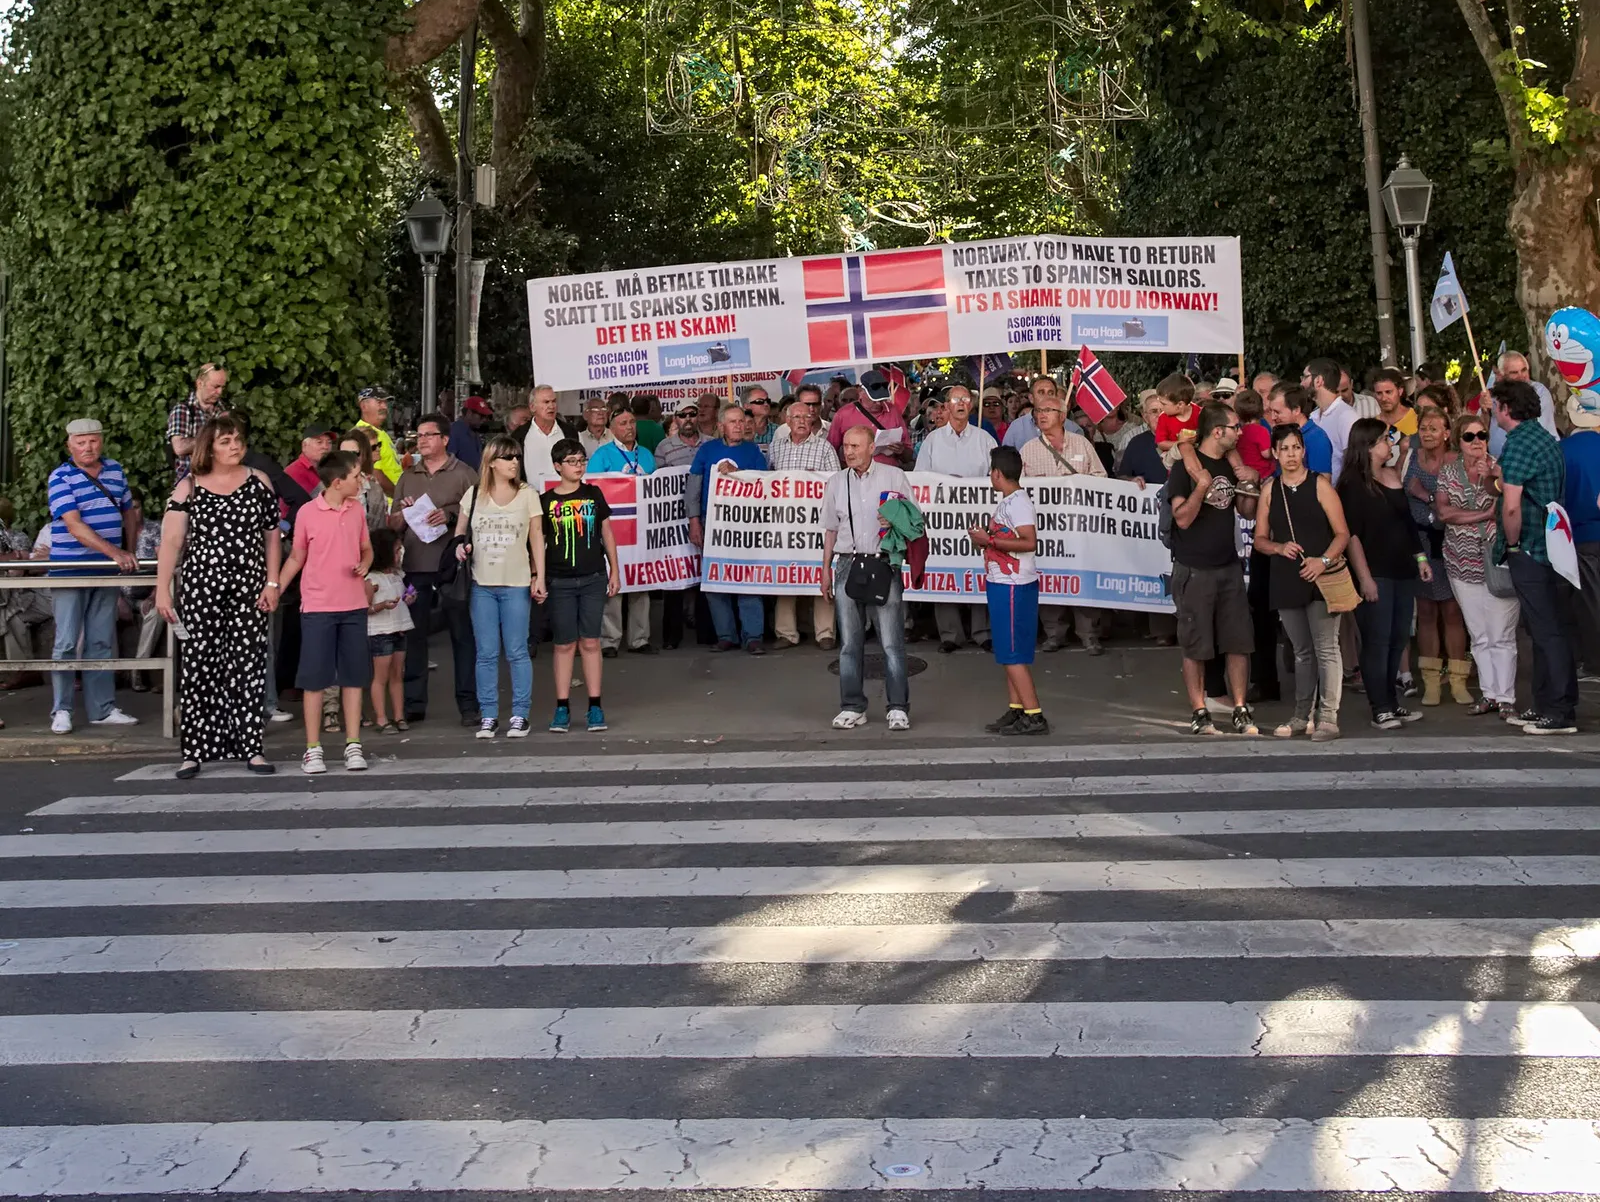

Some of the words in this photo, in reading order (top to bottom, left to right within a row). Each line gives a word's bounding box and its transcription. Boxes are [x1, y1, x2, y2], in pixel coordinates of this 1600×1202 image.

[953, 242, 1031, 267] NORWAY.
[1033, 240, 1067, 261] YOU
[1072, 243, 1115, 264] HAVE
[1118, 245, 1141, 264] TO
[1146, 244, 1216, 264] RETURN
[547, 281, 609, 304] NORGE.
[616, 272, 642, 298] MÅ
[647, 269, 706, 295] BETALE
[708, 264, 778, 289] TILBAKE
[965, 267, 1019, 290] TAXES
[1022, 264, 1042, 284] TO
[1046, 264, 1122, 285] SPANISH
[1127, 268, 1206, 288] SAILORS.
[544, 305, 597, 328] SKATT
[600, 302, 627, 324] TIL
[630, 296, 698, 320] SPANSK
[702, 287, 785, 312] SJØMENN.
[955, 292, 988, 314] IT'S
[991, 291, 1004, 311] A
[1007, 288, 1062, 310] SHAME
[1067, 288, 1091, 308] ON
[1095, 289, 1131, 309] YOU
[1136, 291, 1218, 312] NORWAY!
[596, 325, 627, 346] DET
[631, 323, 651, 343] ER
[656, 320, 676, 340] EN
[680, 314, 737, 338] SKAM!
[1007, 314, 1061, 329] ASOCIACIÓN
[1077, 325, 1099, 339] Long
[1100, 326, 1123, 339] Hope
[1007, 330, 1034, 344] LONG
[1037, 328, 1061, 342] HOPE
[587, 348, 648, 366] ASOCIACIÓN
[665, 356, 686, 369] Long
[686, 354, 709, 367] Hope
[588, 367, 624, 381] LONG
[627, 364, 650, 378] HOPE
[697, 374, 739, 384] DERECHS
[740, 371, 776, 382] SOCIALES
[635, 387, 685, 398] MARINEROS
[687, 386, 734, 398] ESPAÑOLE
[643, 473, 690, 499] NORUE
[771, 477, 790, 499] SÉ
[794, 480, 827, 500] DEC
[934, 482, 945, 504] Á
[948, 486, 999, 505] XENTE
[1039, 486, 1113, 510] DURANTE
[1116, 495, 1138, 513] 40
[648, 499, 686, 524] INDEB
[713, 503, 807, 524] TROUXEMOS
[922, 511, 992, 531] XUDAMO
[1037, 512, 1117, 536] ONSTRUÍR
[646, 524, 691, 550] MARIN
[711, 529, 783, 549] NORUEGA
[1035, 538, 1076, 558] ORA...
[624, 554, 702, 586] VERGÜENZ
[708, 563, 719, 581] A
[722, 564, 773, 584] XUNTA
[776, 563, 833, 584] DÉIXA
[964, 570, 974, 592] É
[1096, 573, 1126, 595] Long
[1128, 576, 1161, 597] Hope
